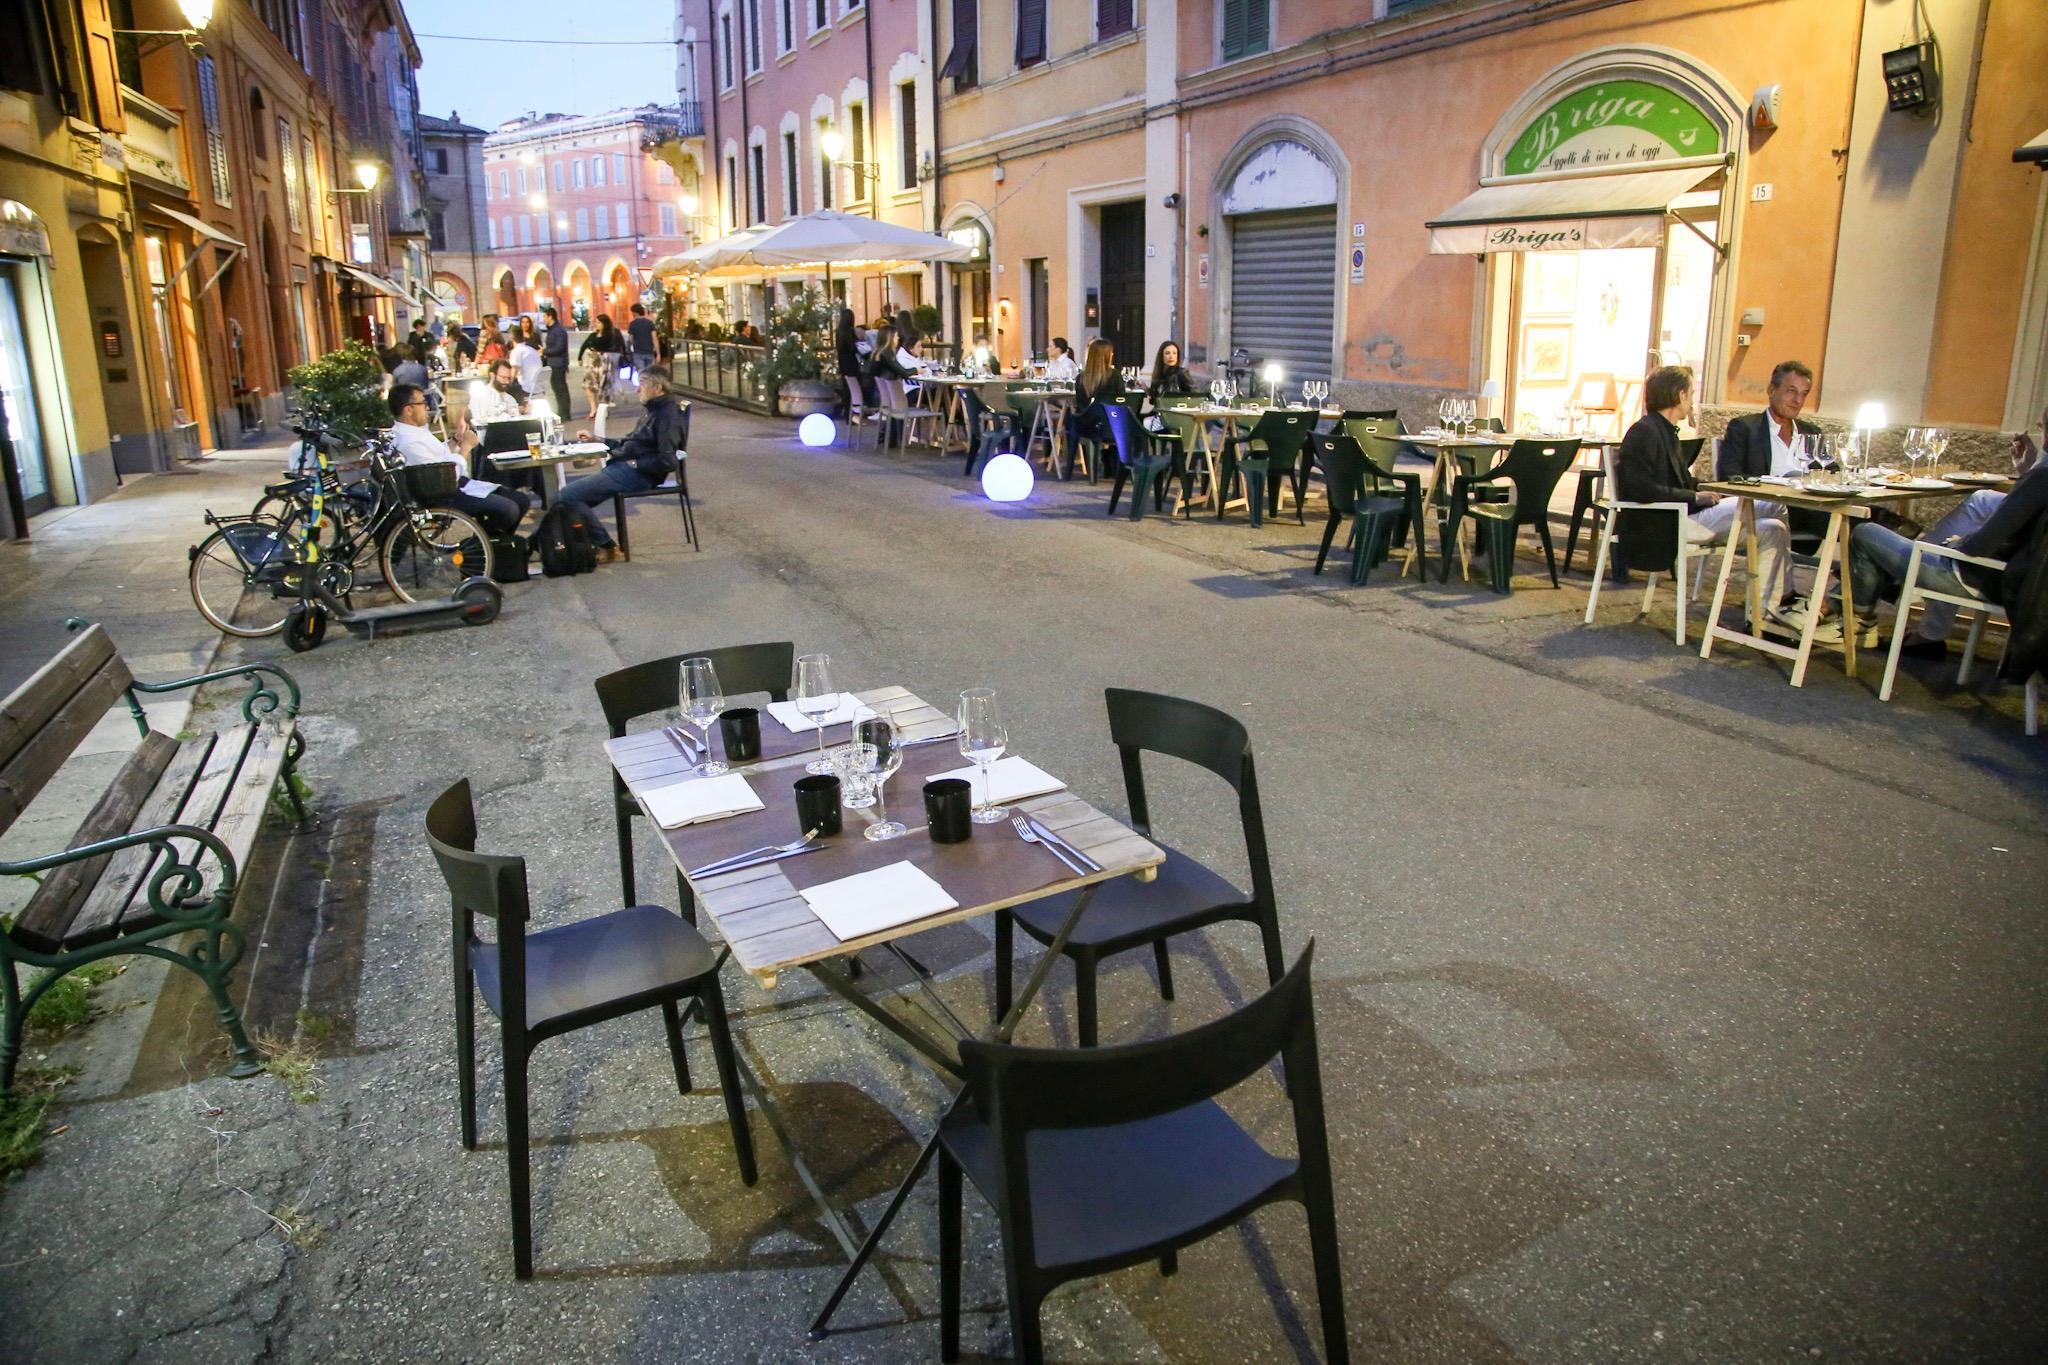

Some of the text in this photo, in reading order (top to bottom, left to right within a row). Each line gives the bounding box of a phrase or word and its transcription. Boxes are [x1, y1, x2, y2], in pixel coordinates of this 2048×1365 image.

[1581, 148, 1592, 163] di
[1626, 143, 1637, 158] di
[1642, 141, 1662, 161] oggi
[1756, 183, 1766, 199] 15
[1490, 227, 1582, 249] Briga's
